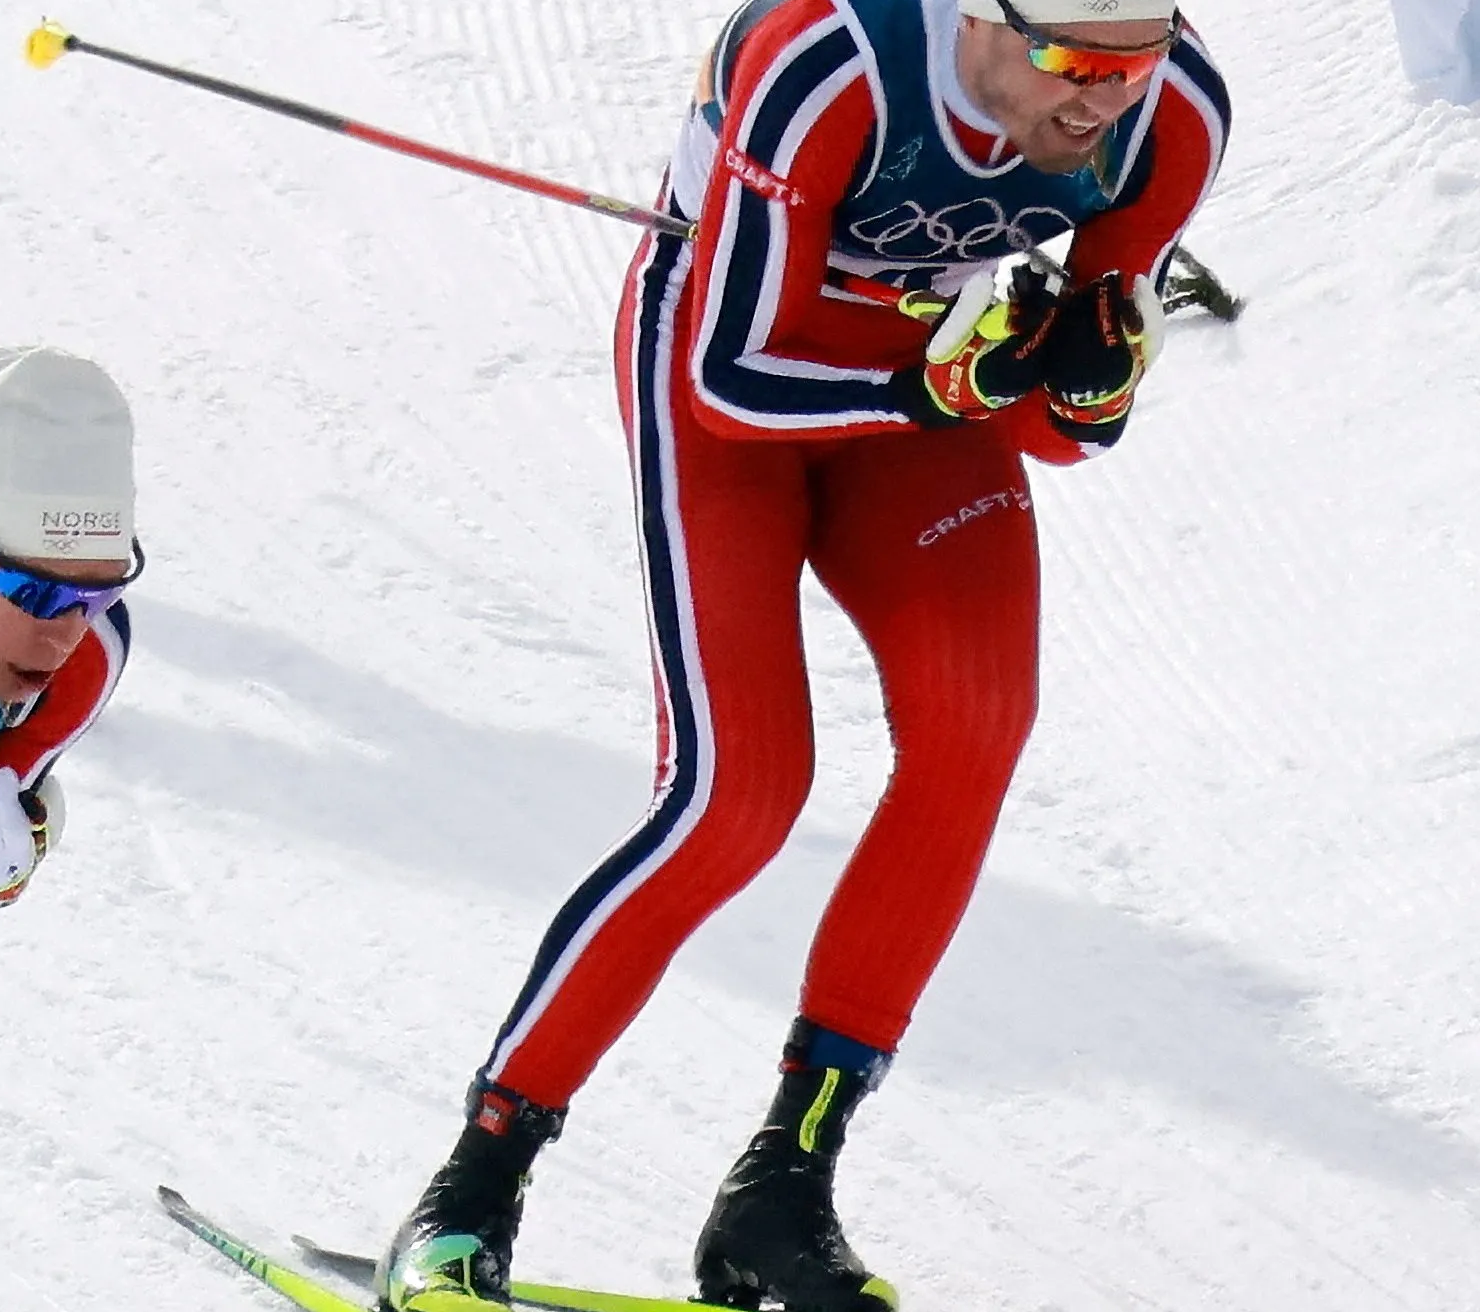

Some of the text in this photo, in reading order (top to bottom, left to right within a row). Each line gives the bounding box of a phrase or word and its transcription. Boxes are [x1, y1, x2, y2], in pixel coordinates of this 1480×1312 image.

[726, 148, 788, 198] CRAFT
[40, 511, 120, 529] NORGE
[918, 492, 1008, 546] CRAFT
